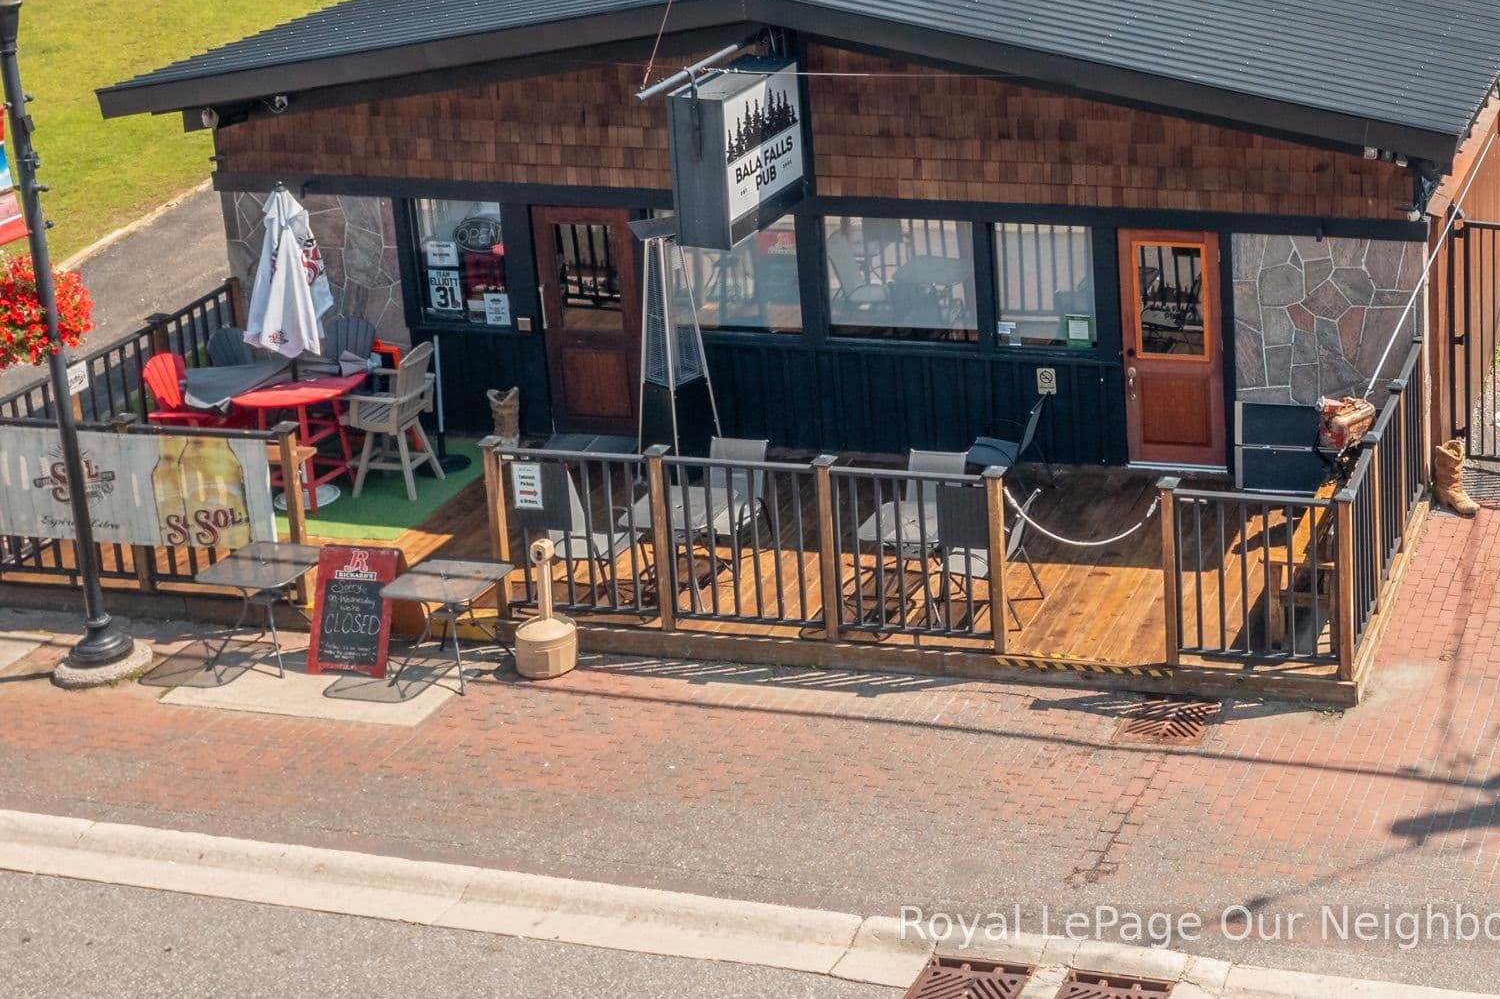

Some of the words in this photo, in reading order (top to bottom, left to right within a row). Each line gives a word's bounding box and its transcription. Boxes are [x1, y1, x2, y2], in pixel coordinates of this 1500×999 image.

[736, 155, 763, 184] BALA
[764, 135, 793, 167] FALLS
[755, 165, 777, 191] PUB
[457, 222, 500, 244] OPEN
[430, 277, 458, 287] ELLIOTT
[435, 286, 461, 309] 31
[50, 459, 99, 504] SL
[343, 550, 369, 573] R
[324, 612, 382, 636] CLOSED
